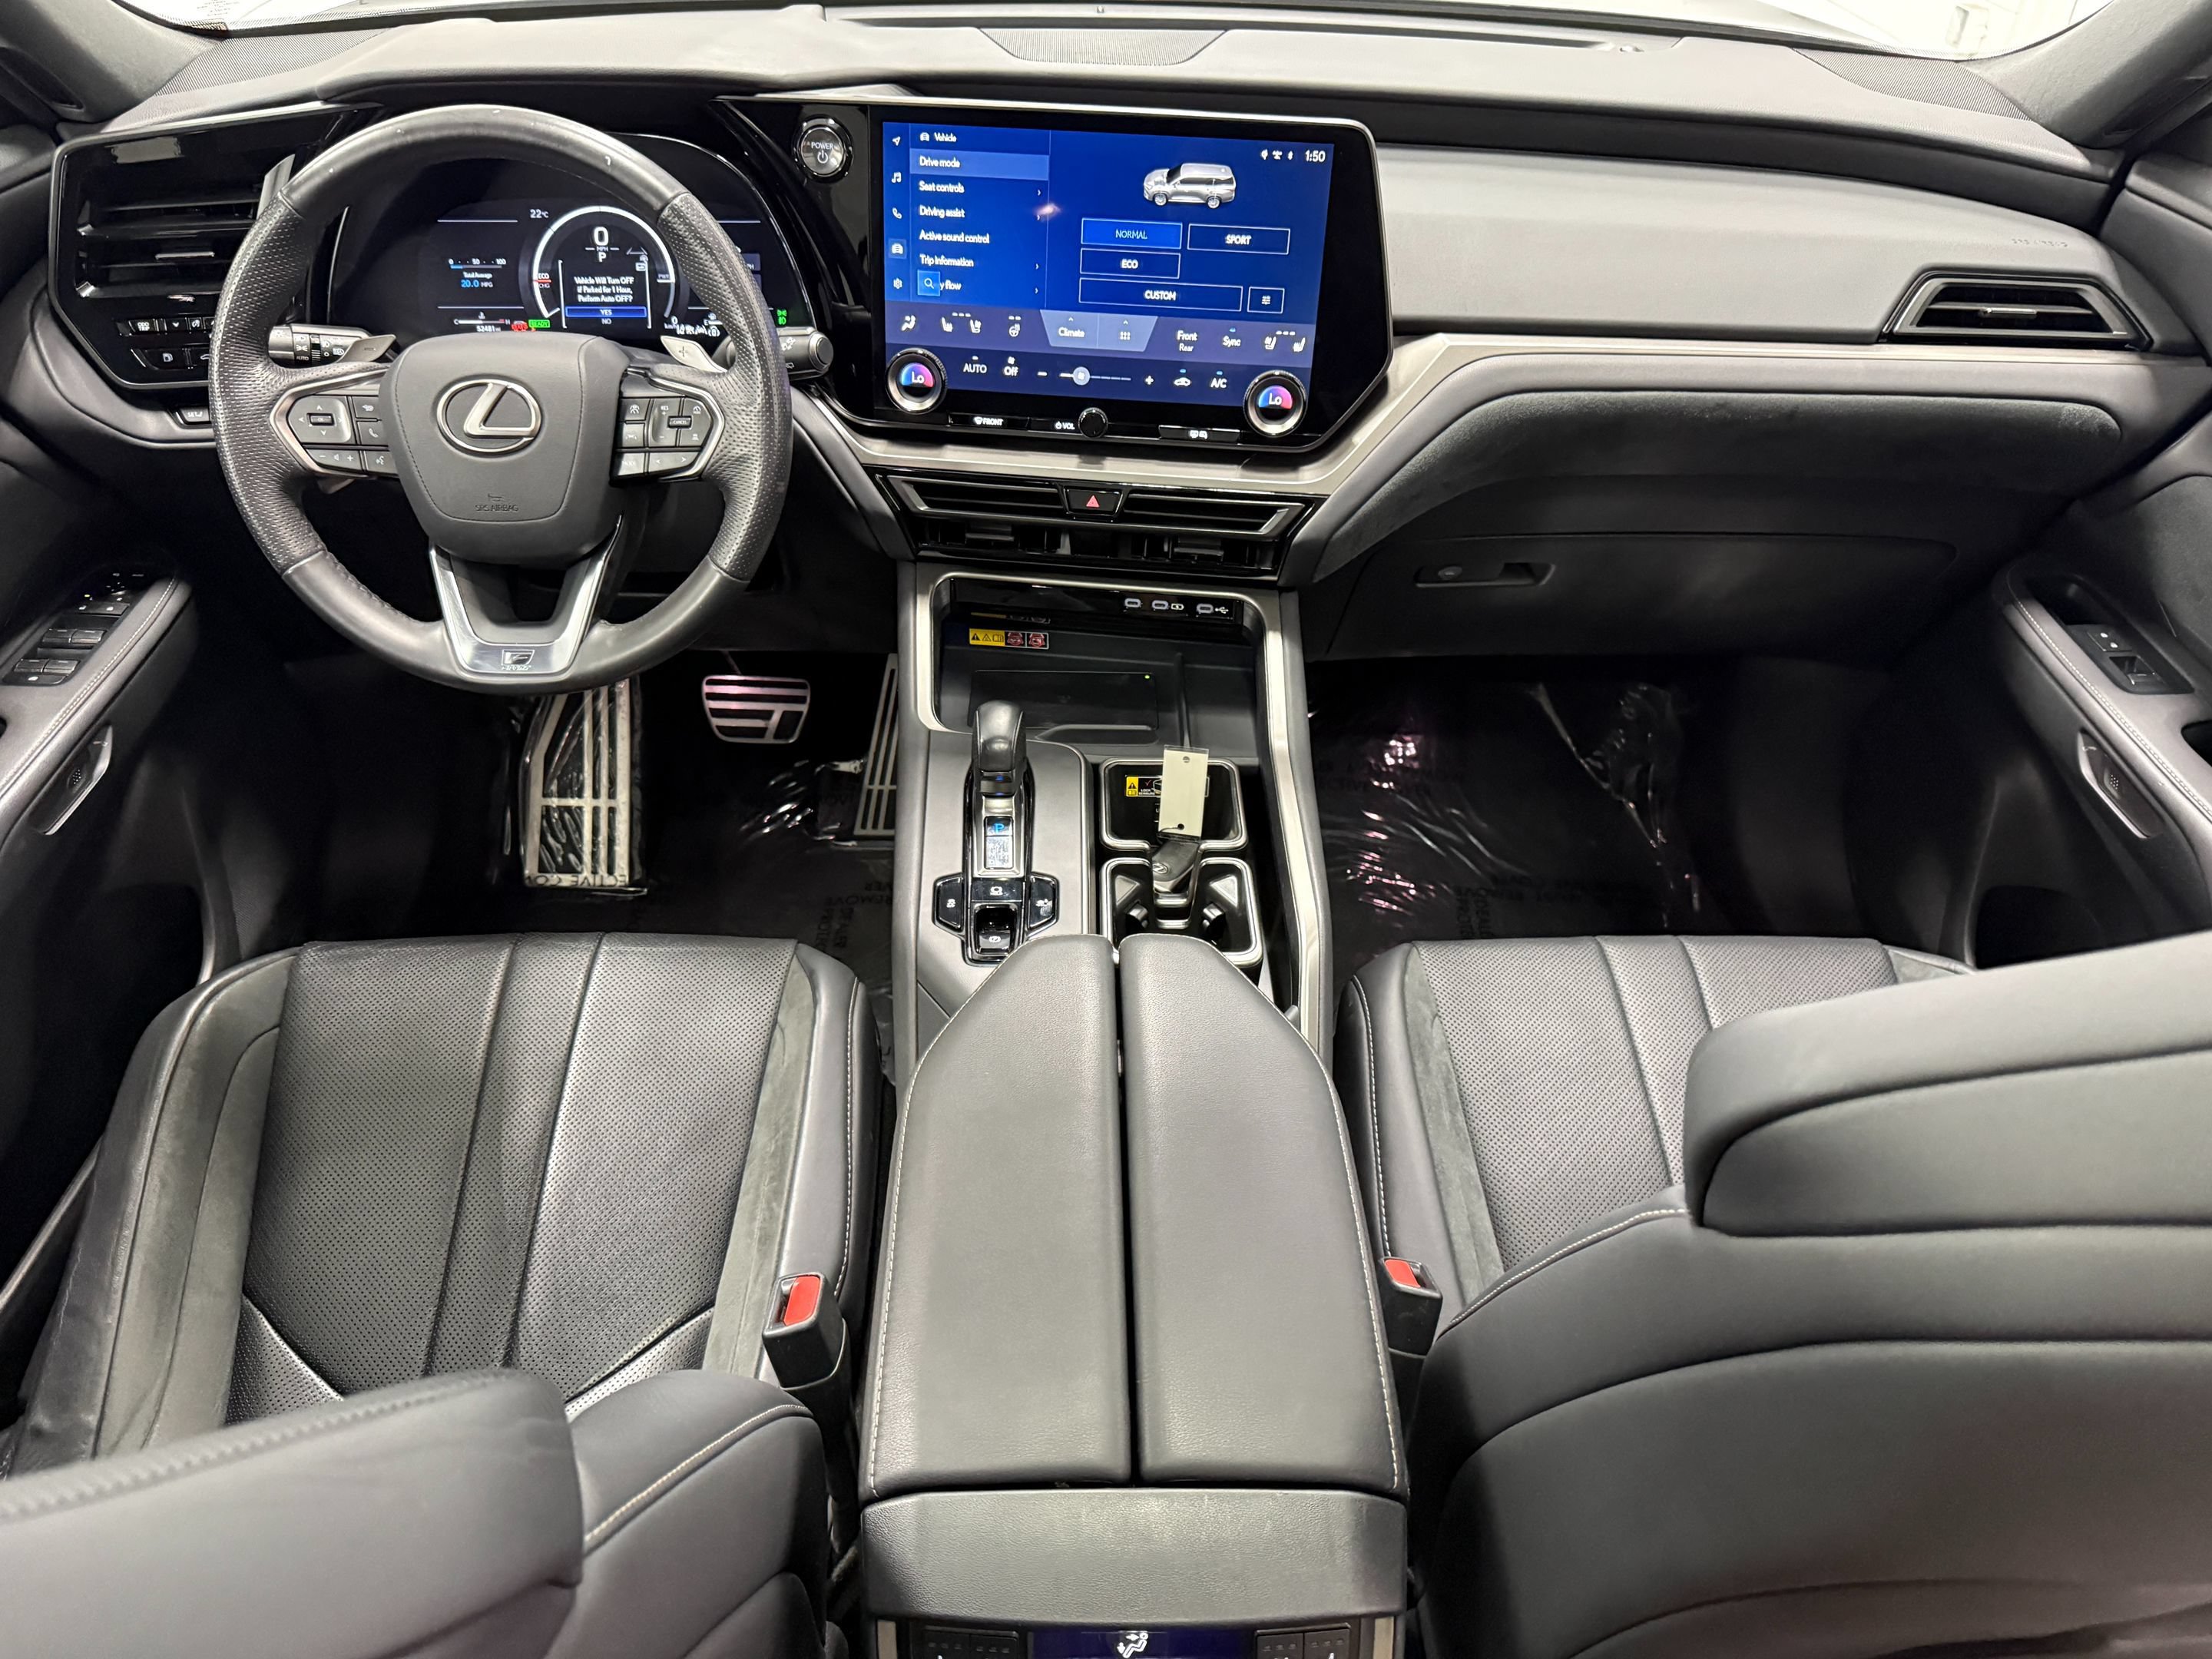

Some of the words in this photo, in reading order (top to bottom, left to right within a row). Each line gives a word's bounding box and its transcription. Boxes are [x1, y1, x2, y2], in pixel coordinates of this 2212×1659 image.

[934, 132, 956, 142] Vehicle
[919, 155, 939, 166] Drive
[939, 157, 960, 167] mode
[1305, 150, 1326, 162] 1:50
[919, 180, 935, 191] Seat
[936, 182, 965, 193] controls
[919, 204, 945, 218] Driving
[945, 207, 965, 217] assist
[593, 226, 609, 246] 0
[919, 229, 942, 240] Active
[942, 231, 964, 242] sound
[965, 233, 990, 243] control
[1115, 229, 1147, 240] NORMAL
[1226, 234, 1251, 245] SPORT
[598, 253, 606, 262] P
[919, 253, 935, 266] Trip
[1121, 259, 1138, 269] ECO
[461, 280, 479, 288] 20.0
[945, 279, 962, 290] flow
[614, 294, 633, 303] OFF?
[1144, 289, 1177, 301] CUSTOM
[1058, 326, 1085, 337] Climate
[1177, 330, 1197, 342] Front
[1223, 336, 1241, 347] Sync
[1179, 343, 1194, 352] Rear
[963, 363, 987, 373] AUTO
[1004, 366, 1018, 376] Off
[912, 372, 924, 384] Lo
[1210, 379, 1227, 389] A/C
[1269, 393, 1283, 406] Lo
[994, 823, 1005, 833] P
